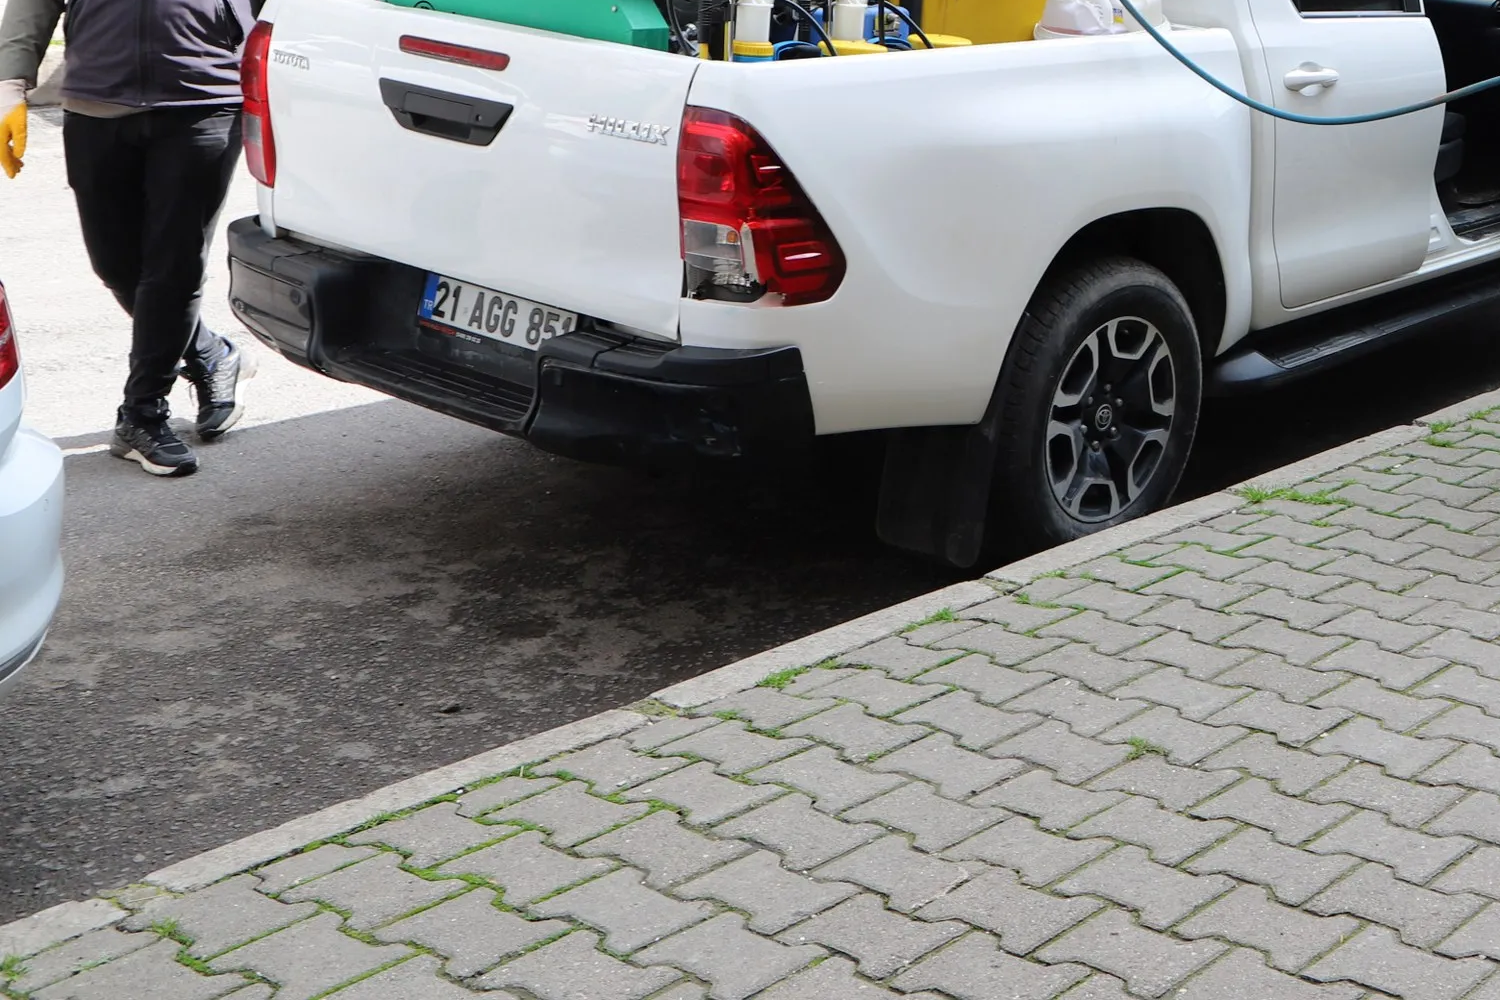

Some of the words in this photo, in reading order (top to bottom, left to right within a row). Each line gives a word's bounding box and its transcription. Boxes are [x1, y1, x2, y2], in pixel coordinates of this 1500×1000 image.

[273, 49, 310, 71] TOYOTA
[587, 114, 671, 146] HILUX
[423, 299, 433, 311] TR
[432, 281, 462, 321] 21
[467, 291, 518, 338] AGG
